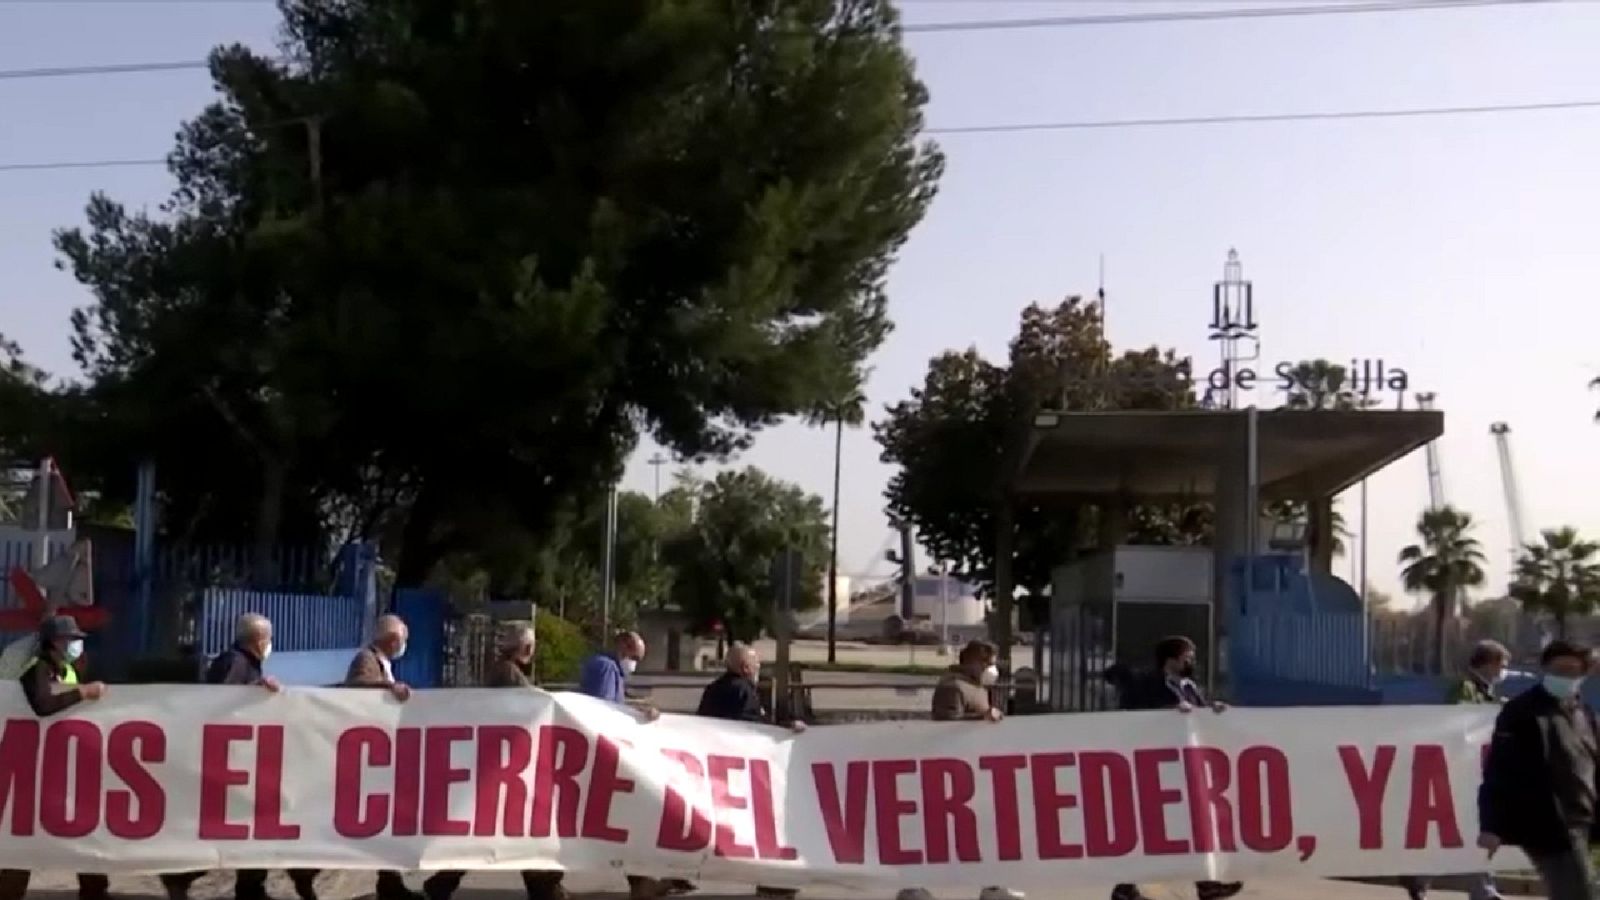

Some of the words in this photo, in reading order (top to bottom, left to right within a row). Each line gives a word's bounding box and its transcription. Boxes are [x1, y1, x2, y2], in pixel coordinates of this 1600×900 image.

[1208, 359, 1256, 390] de
[1275, 359, 1408, 392] Seilla
[198, 724, 301, 841] EL
[334, 724, 636, 843] CIERRE
[657, 748, 797, 860] DEL
[811, 744, 1317, 863] VERTEDERO,
